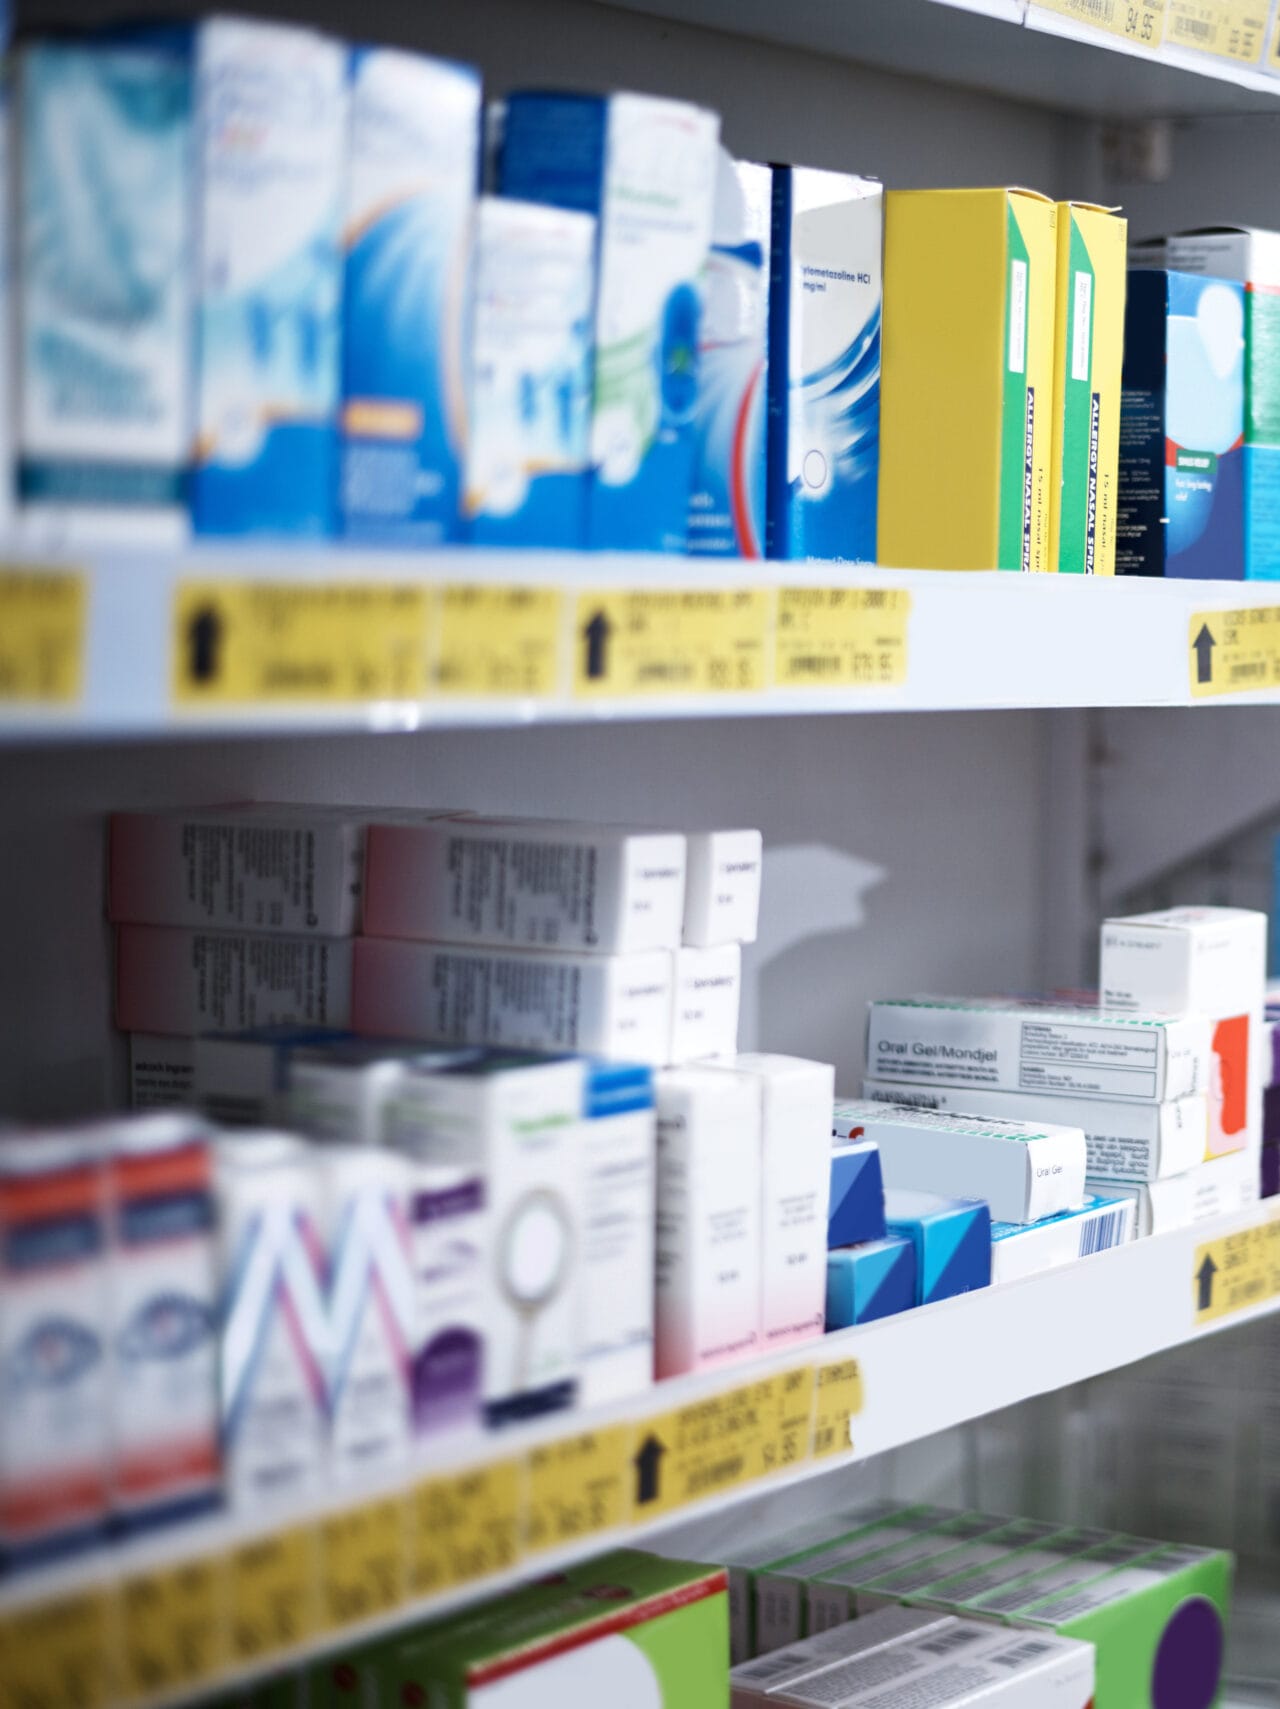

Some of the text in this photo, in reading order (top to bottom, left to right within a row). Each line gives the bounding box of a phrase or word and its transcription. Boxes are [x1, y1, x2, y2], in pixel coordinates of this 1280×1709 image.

[1026, 391, 1034, 468] ALLERGY
[1090, 398, 1099, 474] ALLERGY
[1023, 472, 1032, 529] NASAL
[1087, 477, 1097, 531] NASAL
[878, 1040, 998, 1063] Oral Gel/Mondjel
